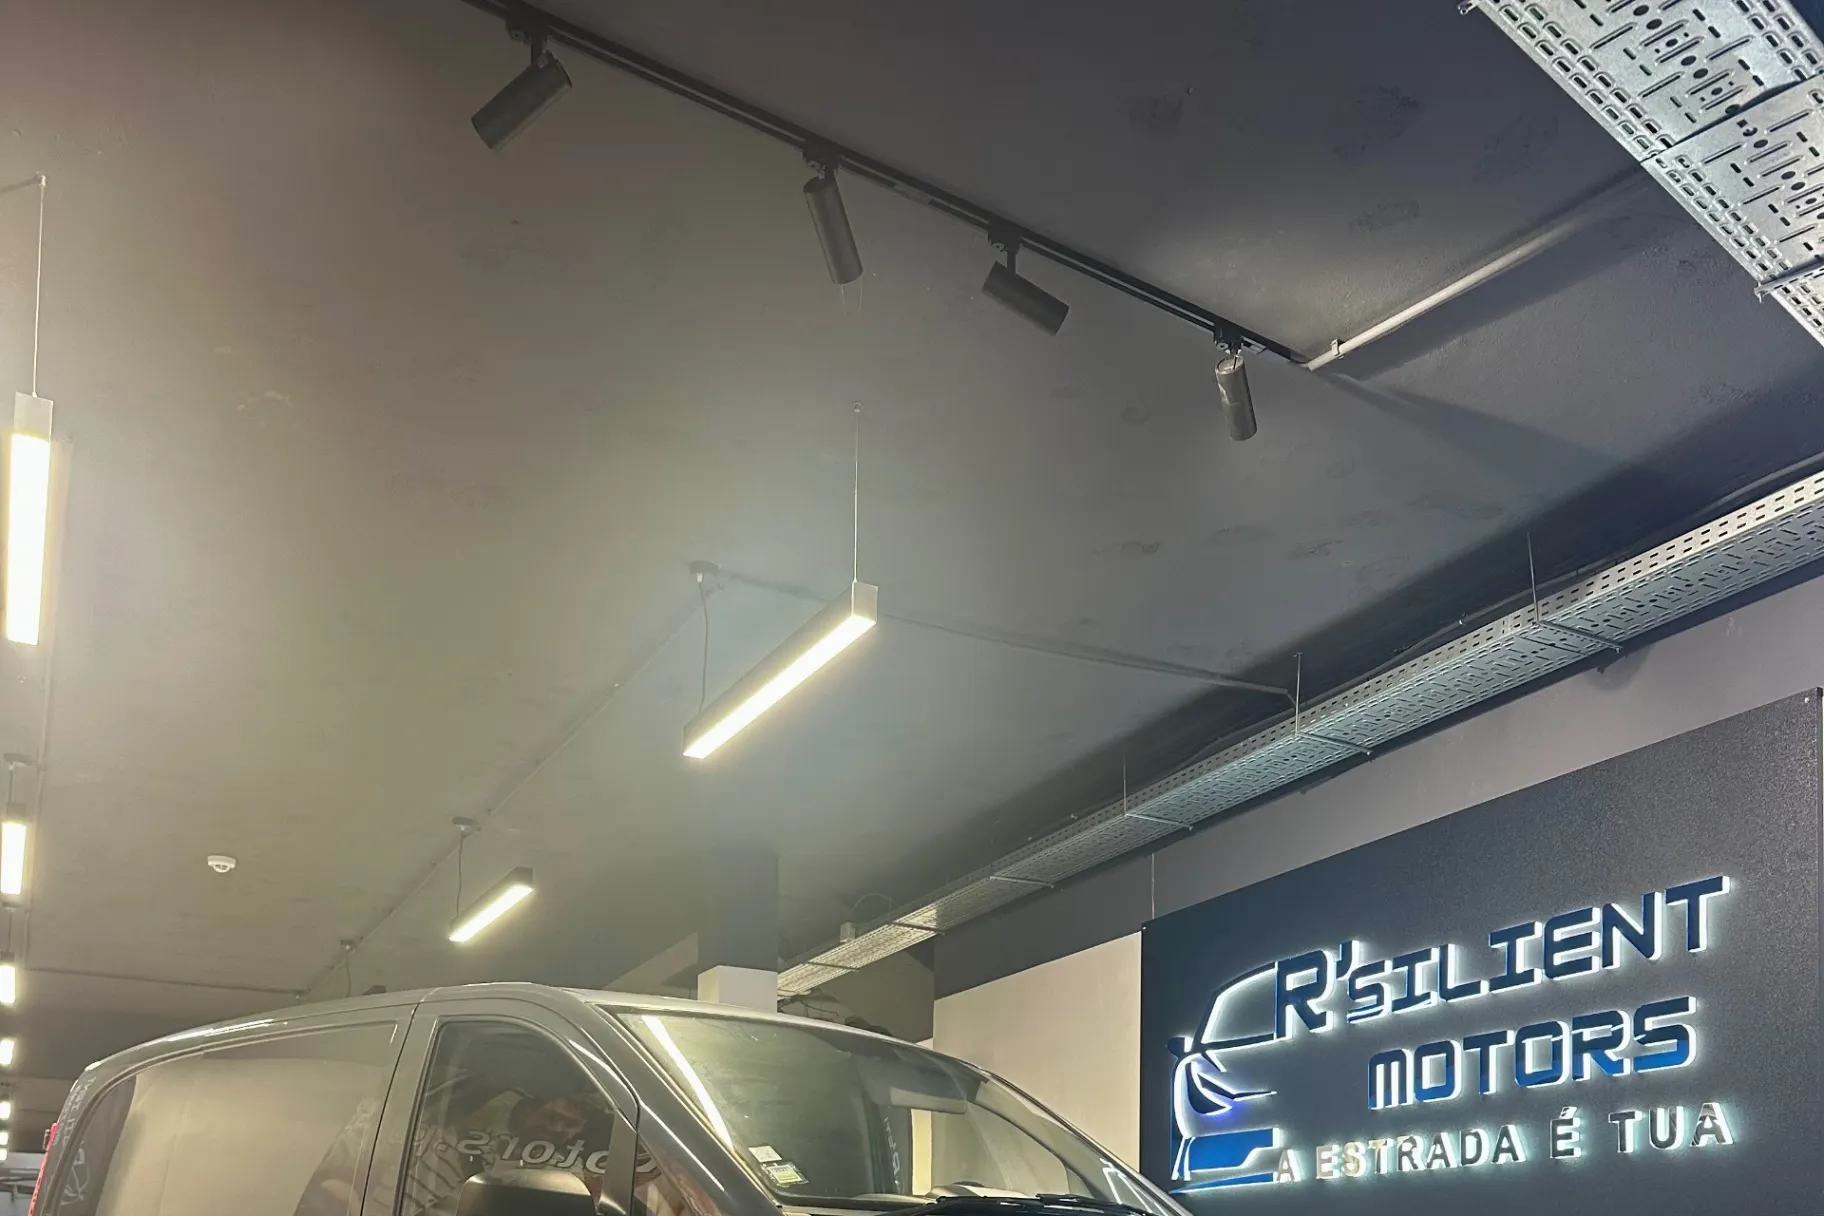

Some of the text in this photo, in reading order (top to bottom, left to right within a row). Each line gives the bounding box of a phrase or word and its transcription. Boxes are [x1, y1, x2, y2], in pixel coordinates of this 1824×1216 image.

[1275, 875, 1731, 1040] R'SILIENT
[1368, 996, 1697, 1110] MOTORS
[1277, 1102, 1735, 1183] A ESTRADA É TUA
